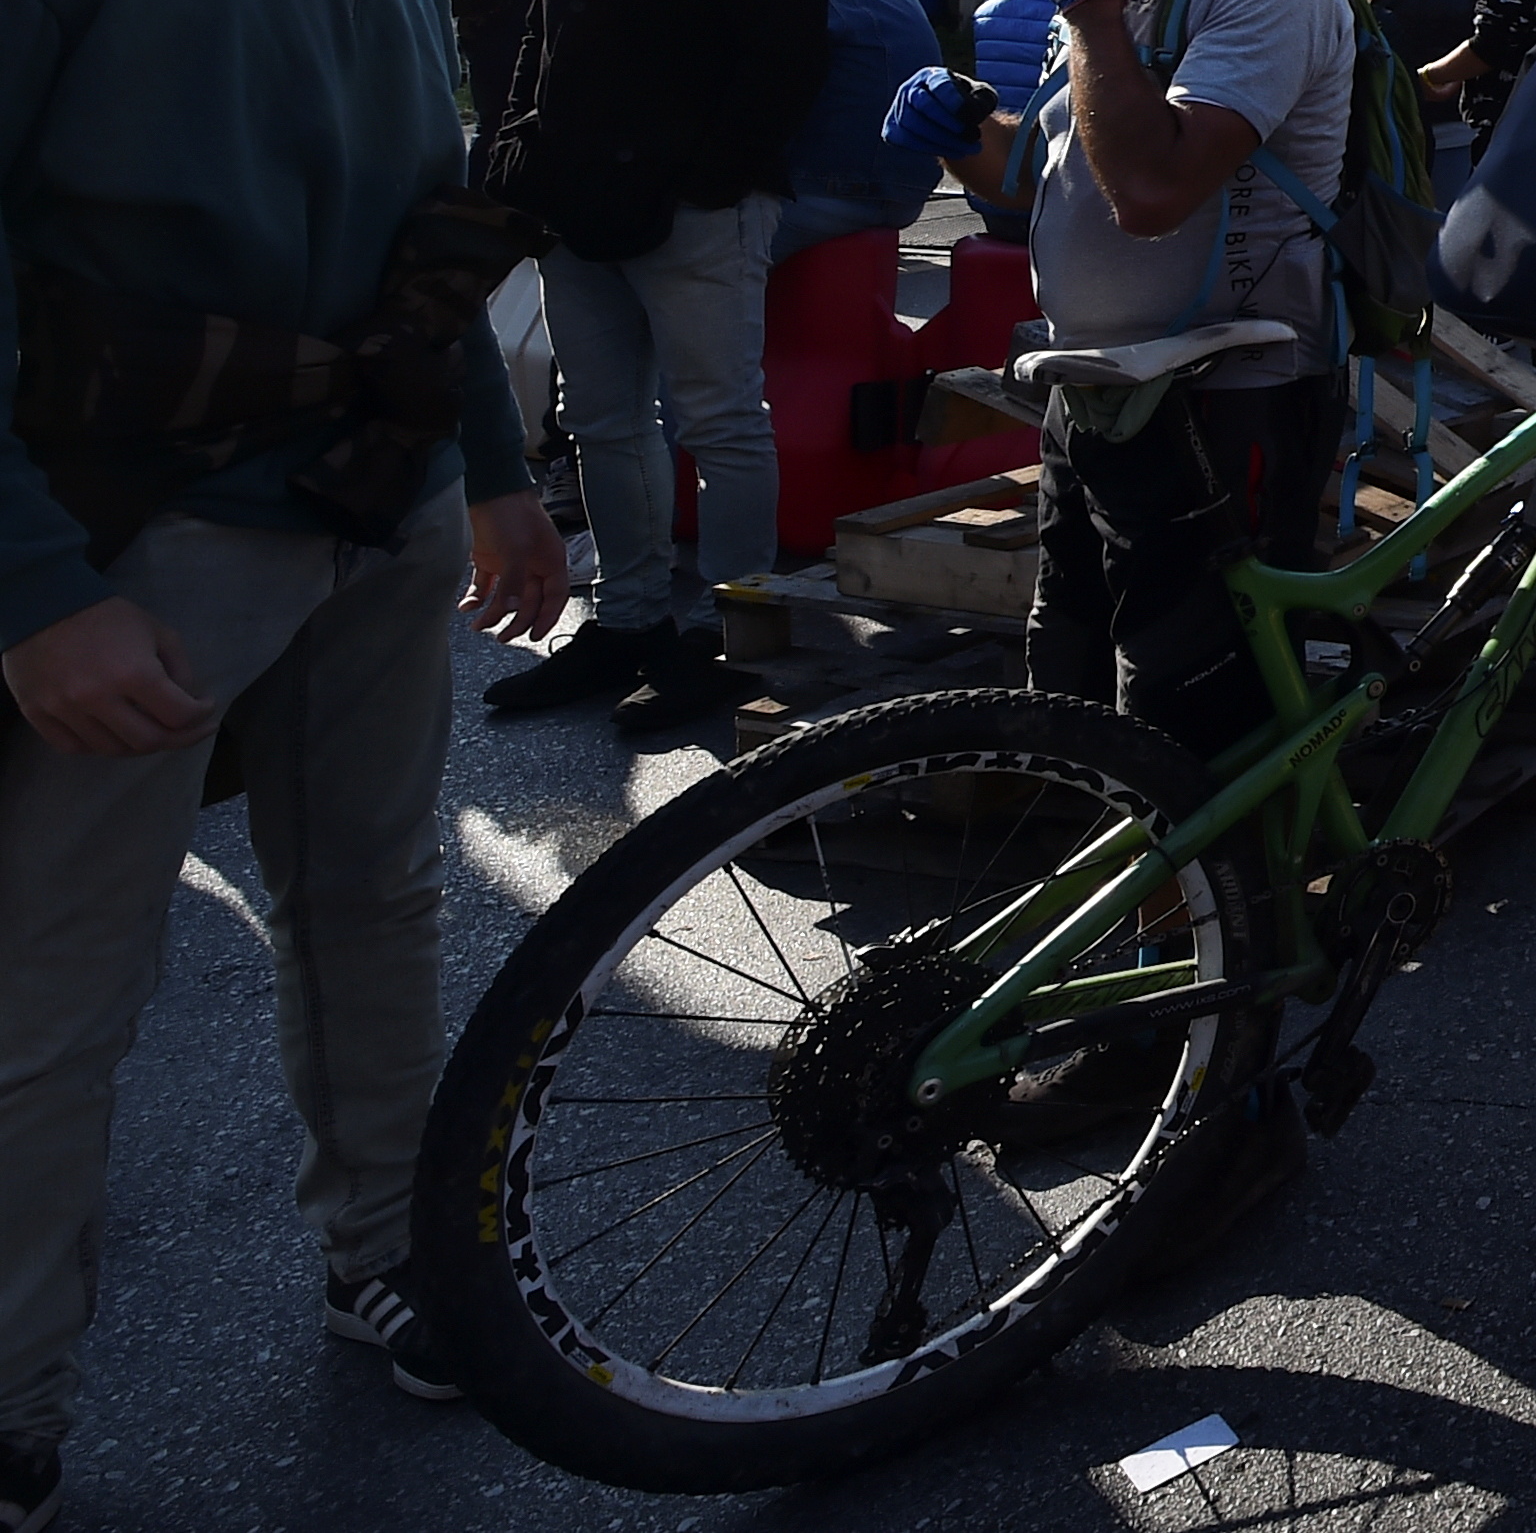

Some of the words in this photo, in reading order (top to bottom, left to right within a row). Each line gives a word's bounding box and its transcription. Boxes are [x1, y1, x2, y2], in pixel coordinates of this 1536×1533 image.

[1229, 164, 1257, 218] ORE
[1225, 232, 1255, 292] BIKE
[1238, 302, 1264, 362] WR
[1149, 982, 1252, 1019] www.ixs.com
[478, 1017, 553, 1243] MAXXIS
